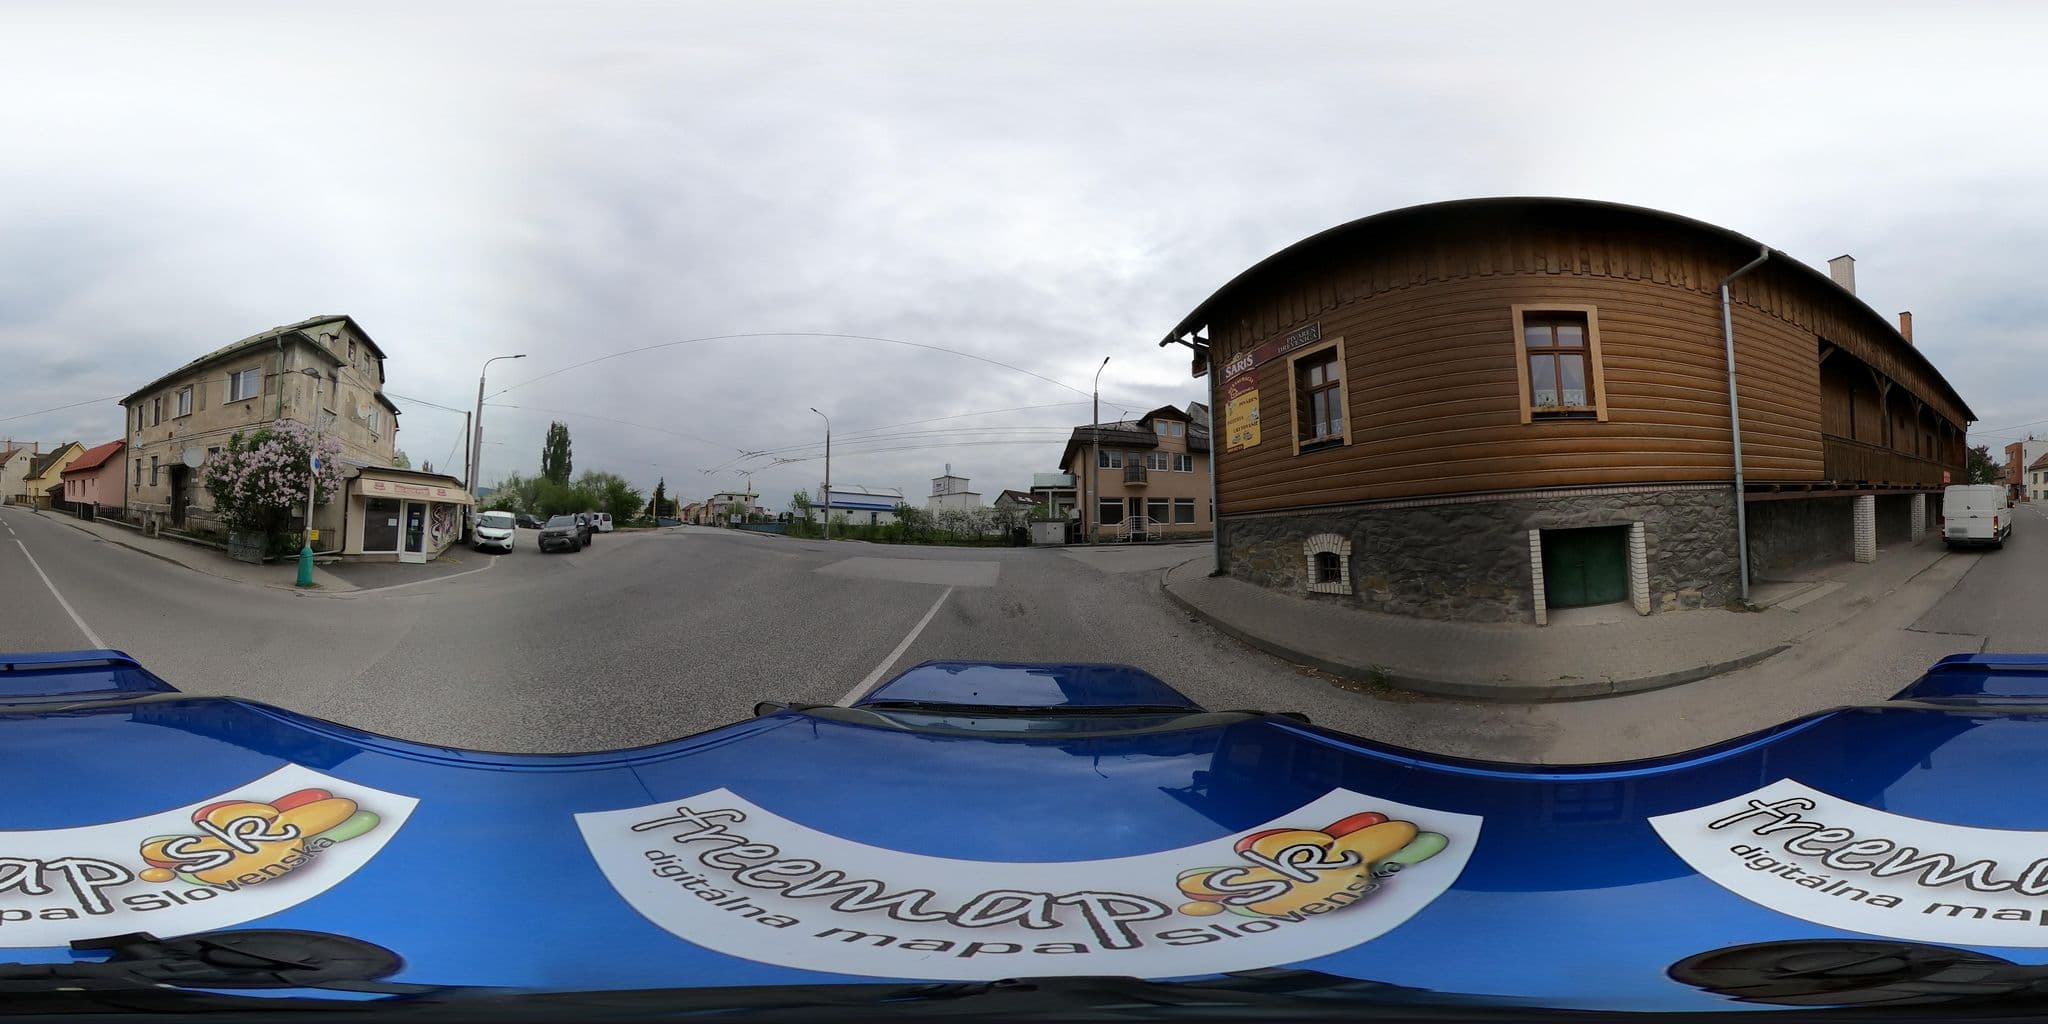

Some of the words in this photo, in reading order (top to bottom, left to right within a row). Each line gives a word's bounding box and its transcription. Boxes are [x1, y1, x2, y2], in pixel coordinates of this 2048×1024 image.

[122, 835, 337, 912] Slovenska
[631, 806, 1172, 950] freemap
[1708, 797, 2048, 896] freem
[1730, 842, 1904, 910] digitálna
[1922, 901, 2048, 926] ma
[645, 849, 801, 929] digitálna
[814, 927, 1090, 958] mapa
